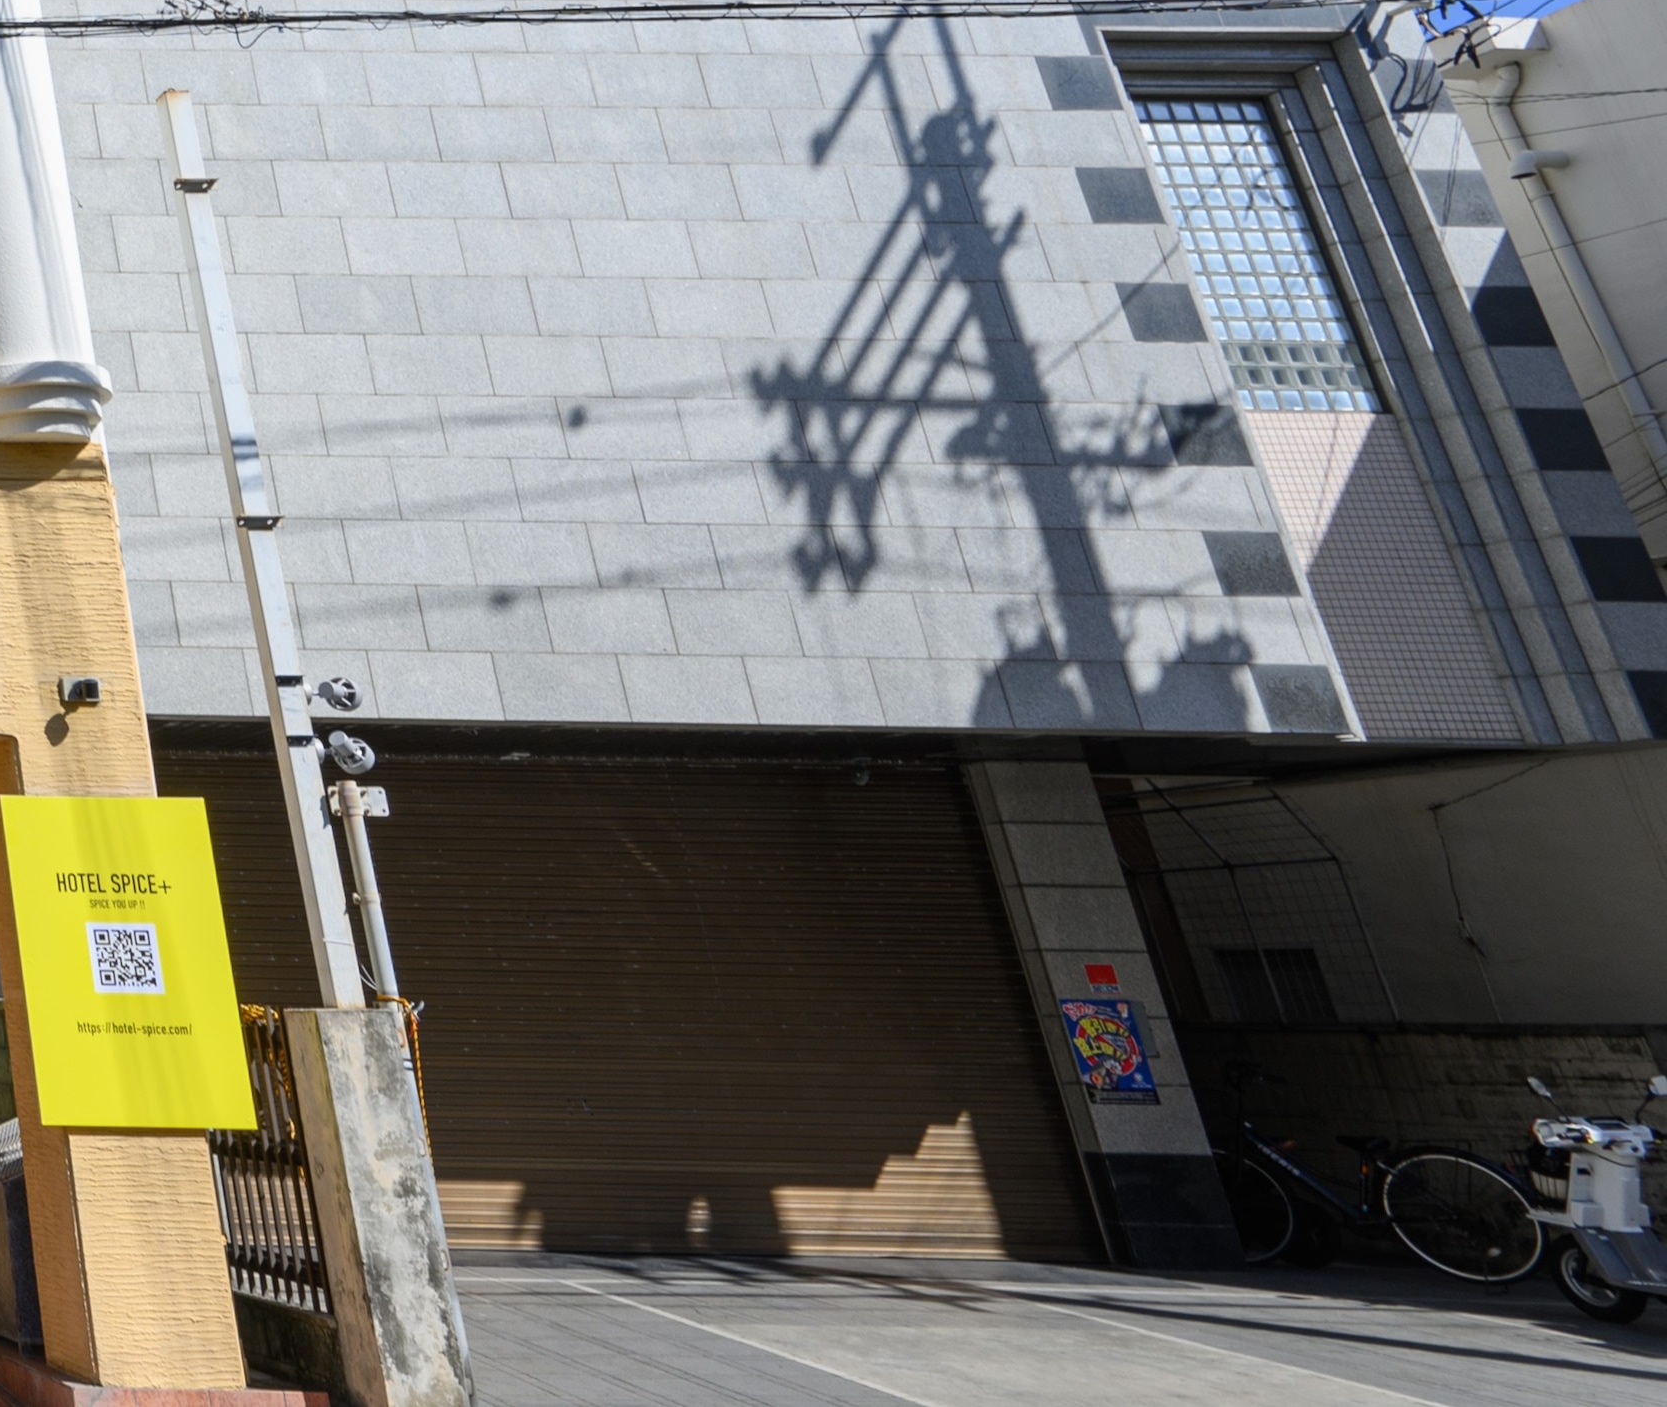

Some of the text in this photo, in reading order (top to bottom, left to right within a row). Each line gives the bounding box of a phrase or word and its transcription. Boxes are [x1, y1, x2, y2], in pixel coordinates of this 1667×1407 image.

[56, 872, 172, 895] HOTEL SPICE+
[89, 899, 110, 909] SPICE
[111, 900, 127, 909] YOU
[128, 900, 138, 909] UP
[77, 1021, 193, 1037] https://hotel-spice.com/
